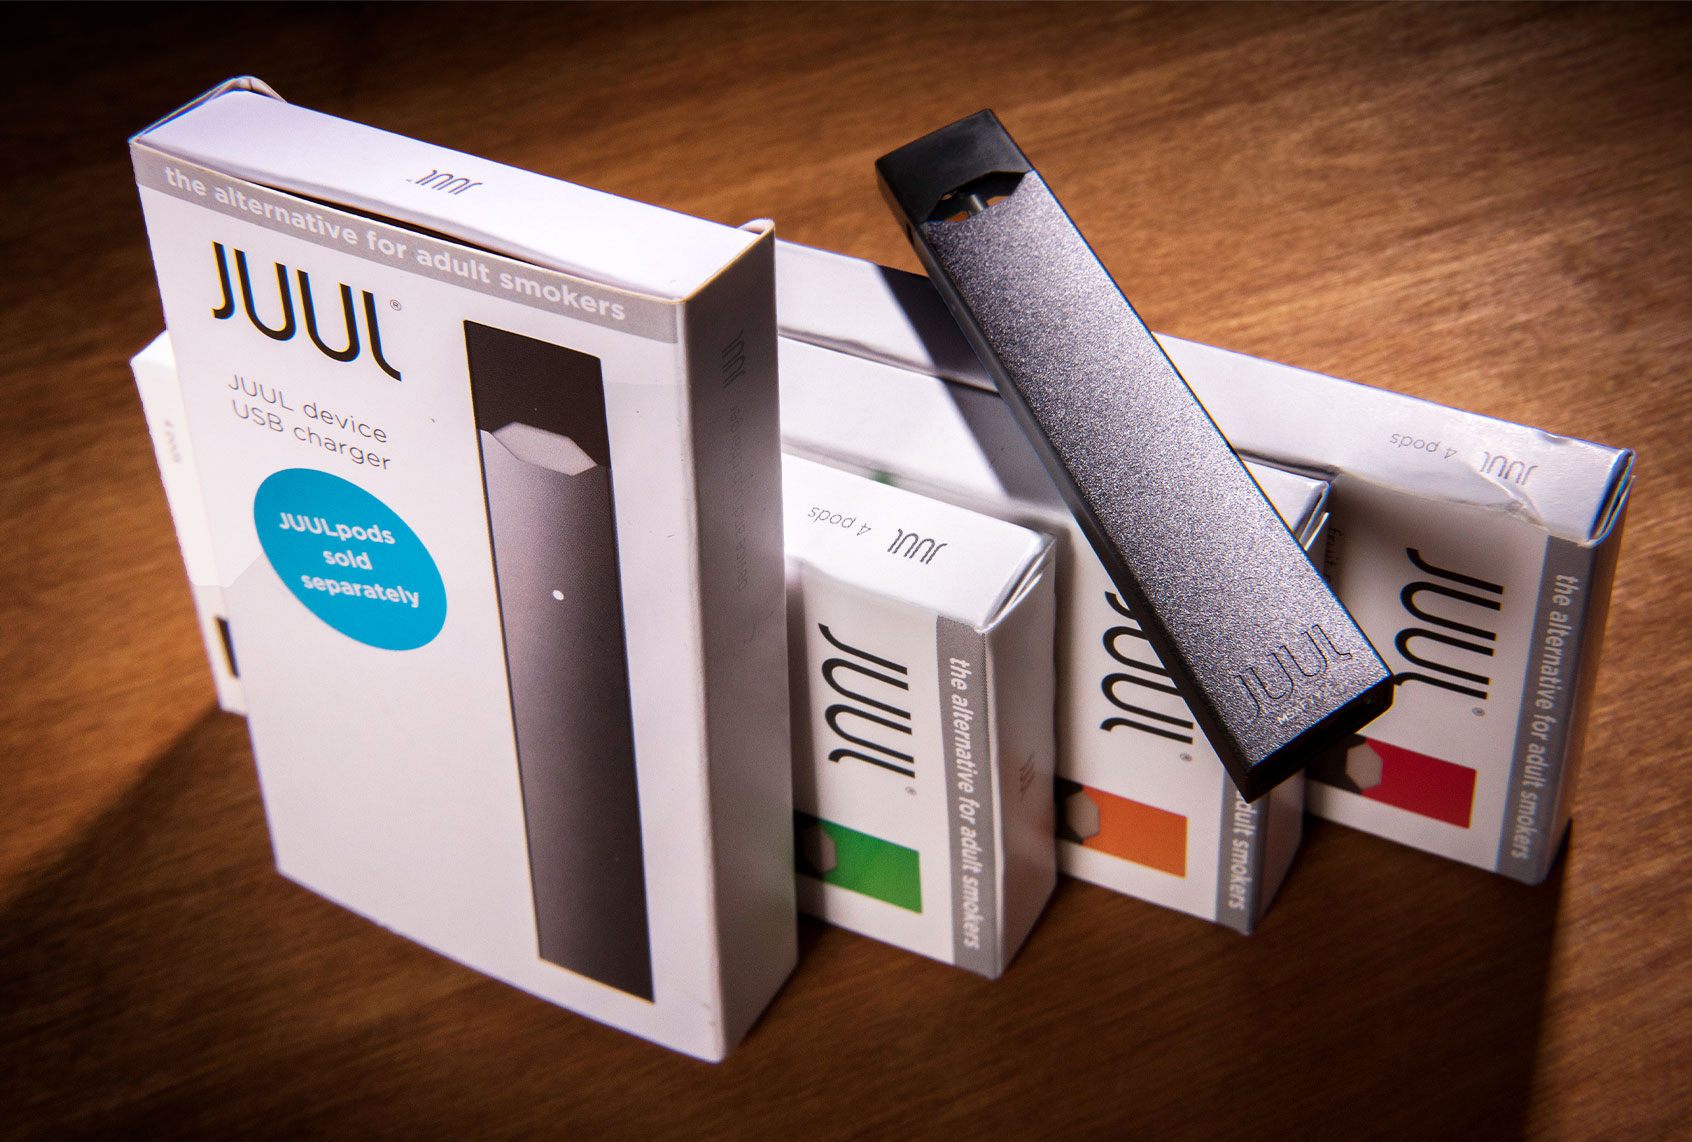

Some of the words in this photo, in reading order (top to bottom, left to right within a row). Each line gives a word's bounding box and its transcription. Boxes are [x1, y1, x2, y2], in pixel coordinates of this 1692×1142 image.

[415, 169, 483, 195] JUUL
[163, 166, 207, 196] the
[213, 186, 358, 245] alternative
[366, 230, 407, 259] for
[415, 249, 491, 284] adult
[500, 273, 626, 320] smokers
[228, 373, 294, 411] JUUL
[303, 402, 388, 443] device
[230, 399, 284, 432] USB
[293, 424, 391, 470] charger
[1389, 431, 1441, 454] pods
[1443, 447, 1458, 460] 4
[1480, 450, 1539, 487] JUUL
[279, 512, 396, 545] JUULpods
[807, 504, 857, 537] pods
[856, 521, 872, 537] 4
[323, 549, 373, 571] sold
[887, 528, 949, 565] JUUL
[301, 574, 420, 609] separately
[1551, 574, 1581, 606] the
[949, 657, 973, 691] the
[1234, 624, 1354, 724] JUUL
[1535, 611, 1574, 710] alternative
[951, 693, 979, 793] alternative
[1530, 714, 1558, 741] for
[1522, 743, 1550, 789] adult
[958, 796, 981, 824] for
[1511, 791, 1539, 860] smokers
[960, 825, 984, 874] adult
[1227, 838, 1253, 911] smokers
[962, 875, 985, 950] smokers
